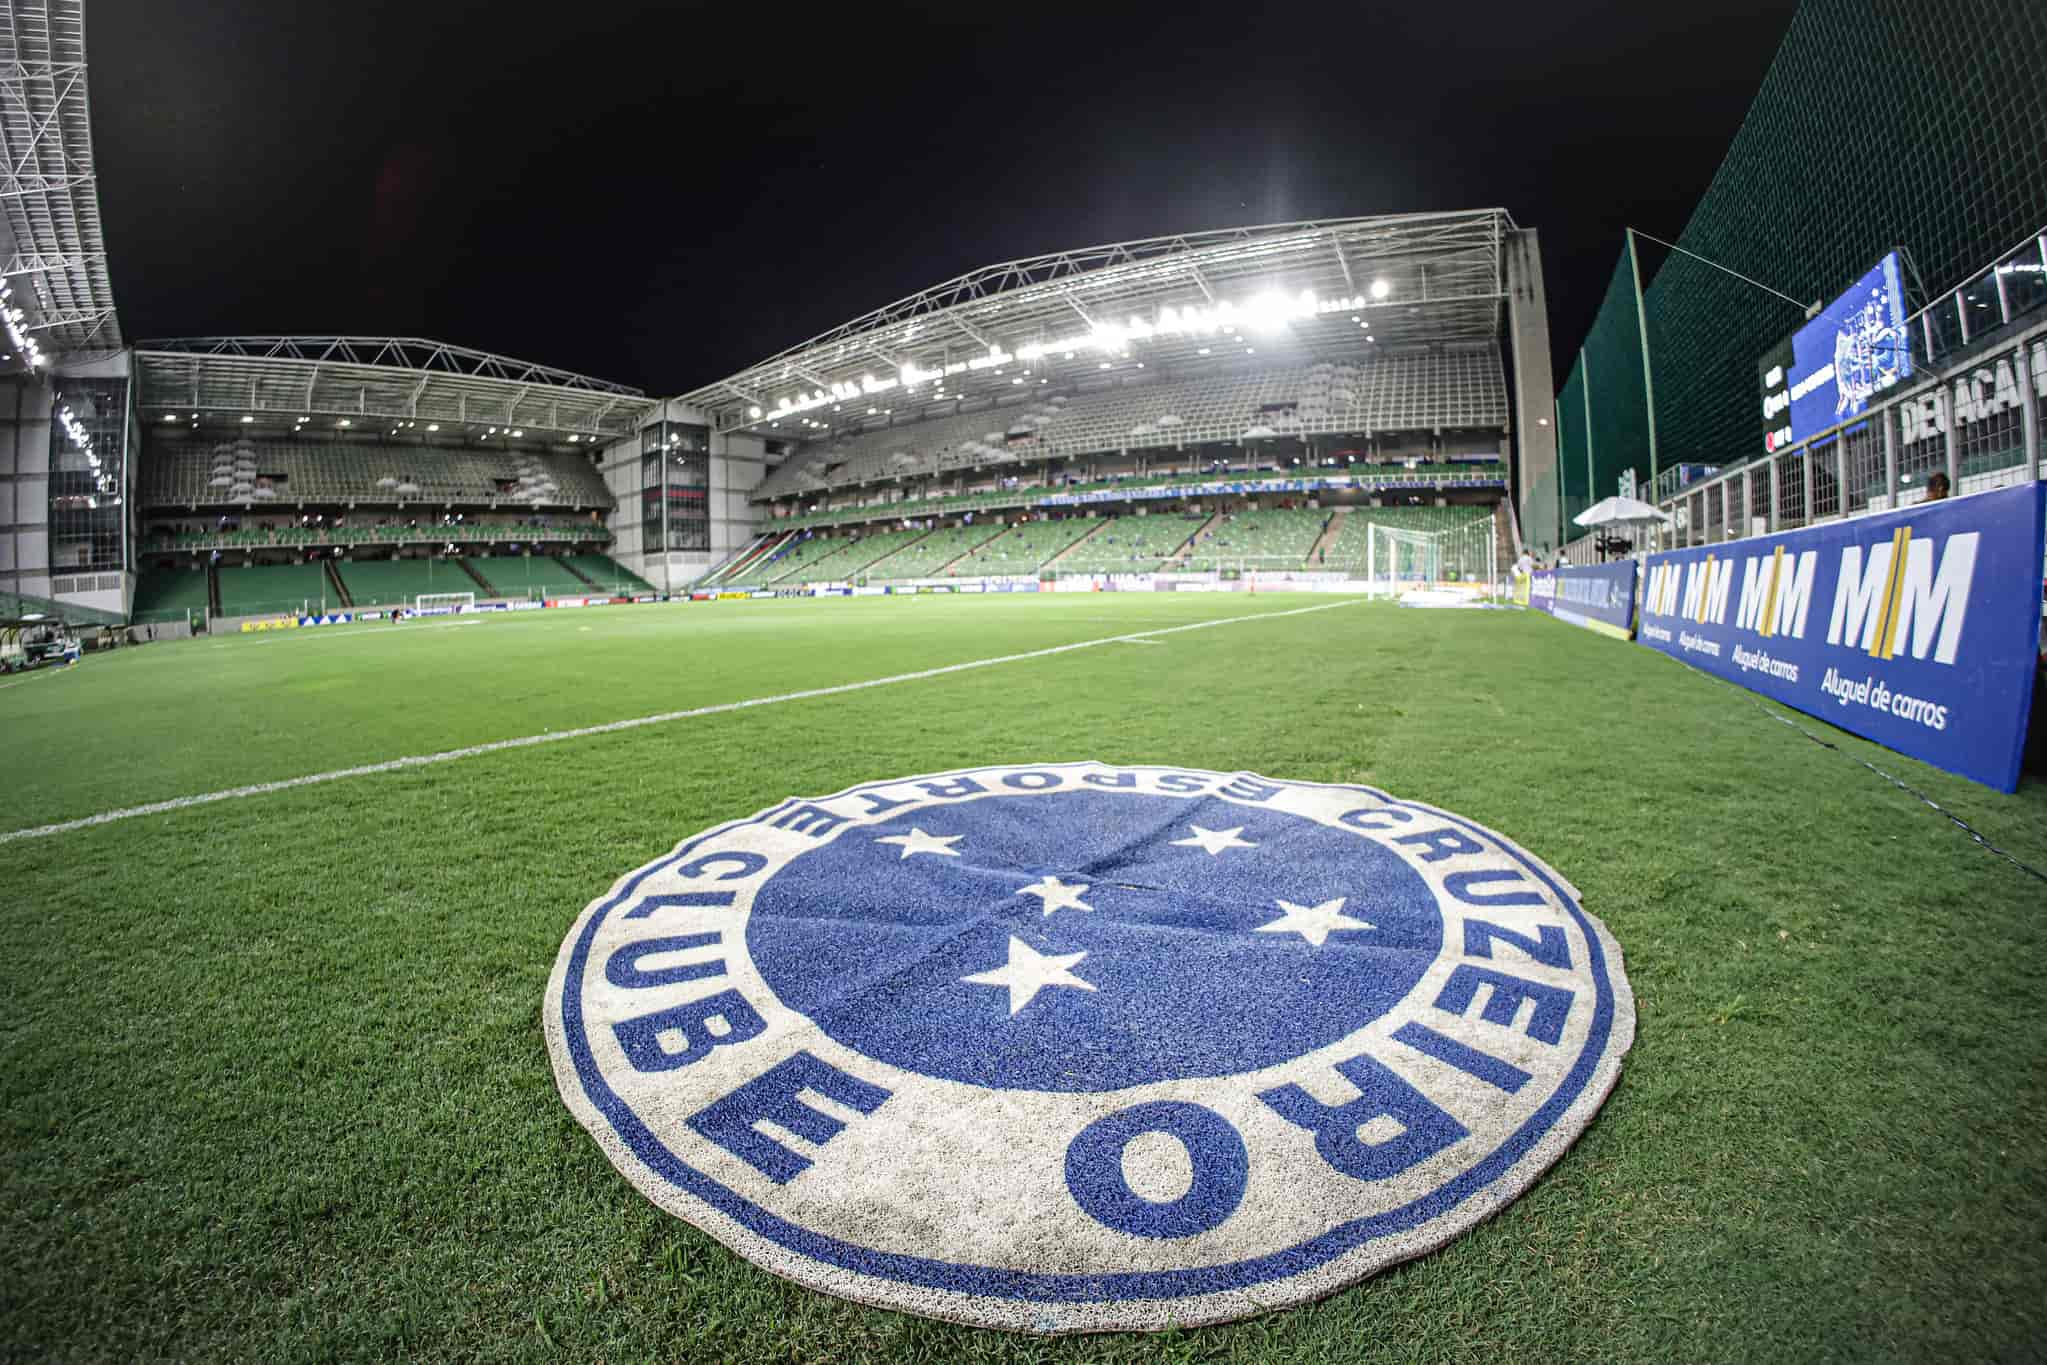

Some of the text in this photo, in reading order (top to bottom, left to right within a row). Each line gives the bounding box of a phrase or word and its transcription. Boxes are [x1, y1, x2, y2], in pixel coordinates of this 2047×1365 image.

[1732, 644, 1798, 683] Aluguel de carros
[1821, 667, 1947, 730] Aluguel de carros
[605, 771, 1285, 1186] ESPORTE CLUBE
[1063, 807, 1576, 1240] CRUZEIRO
